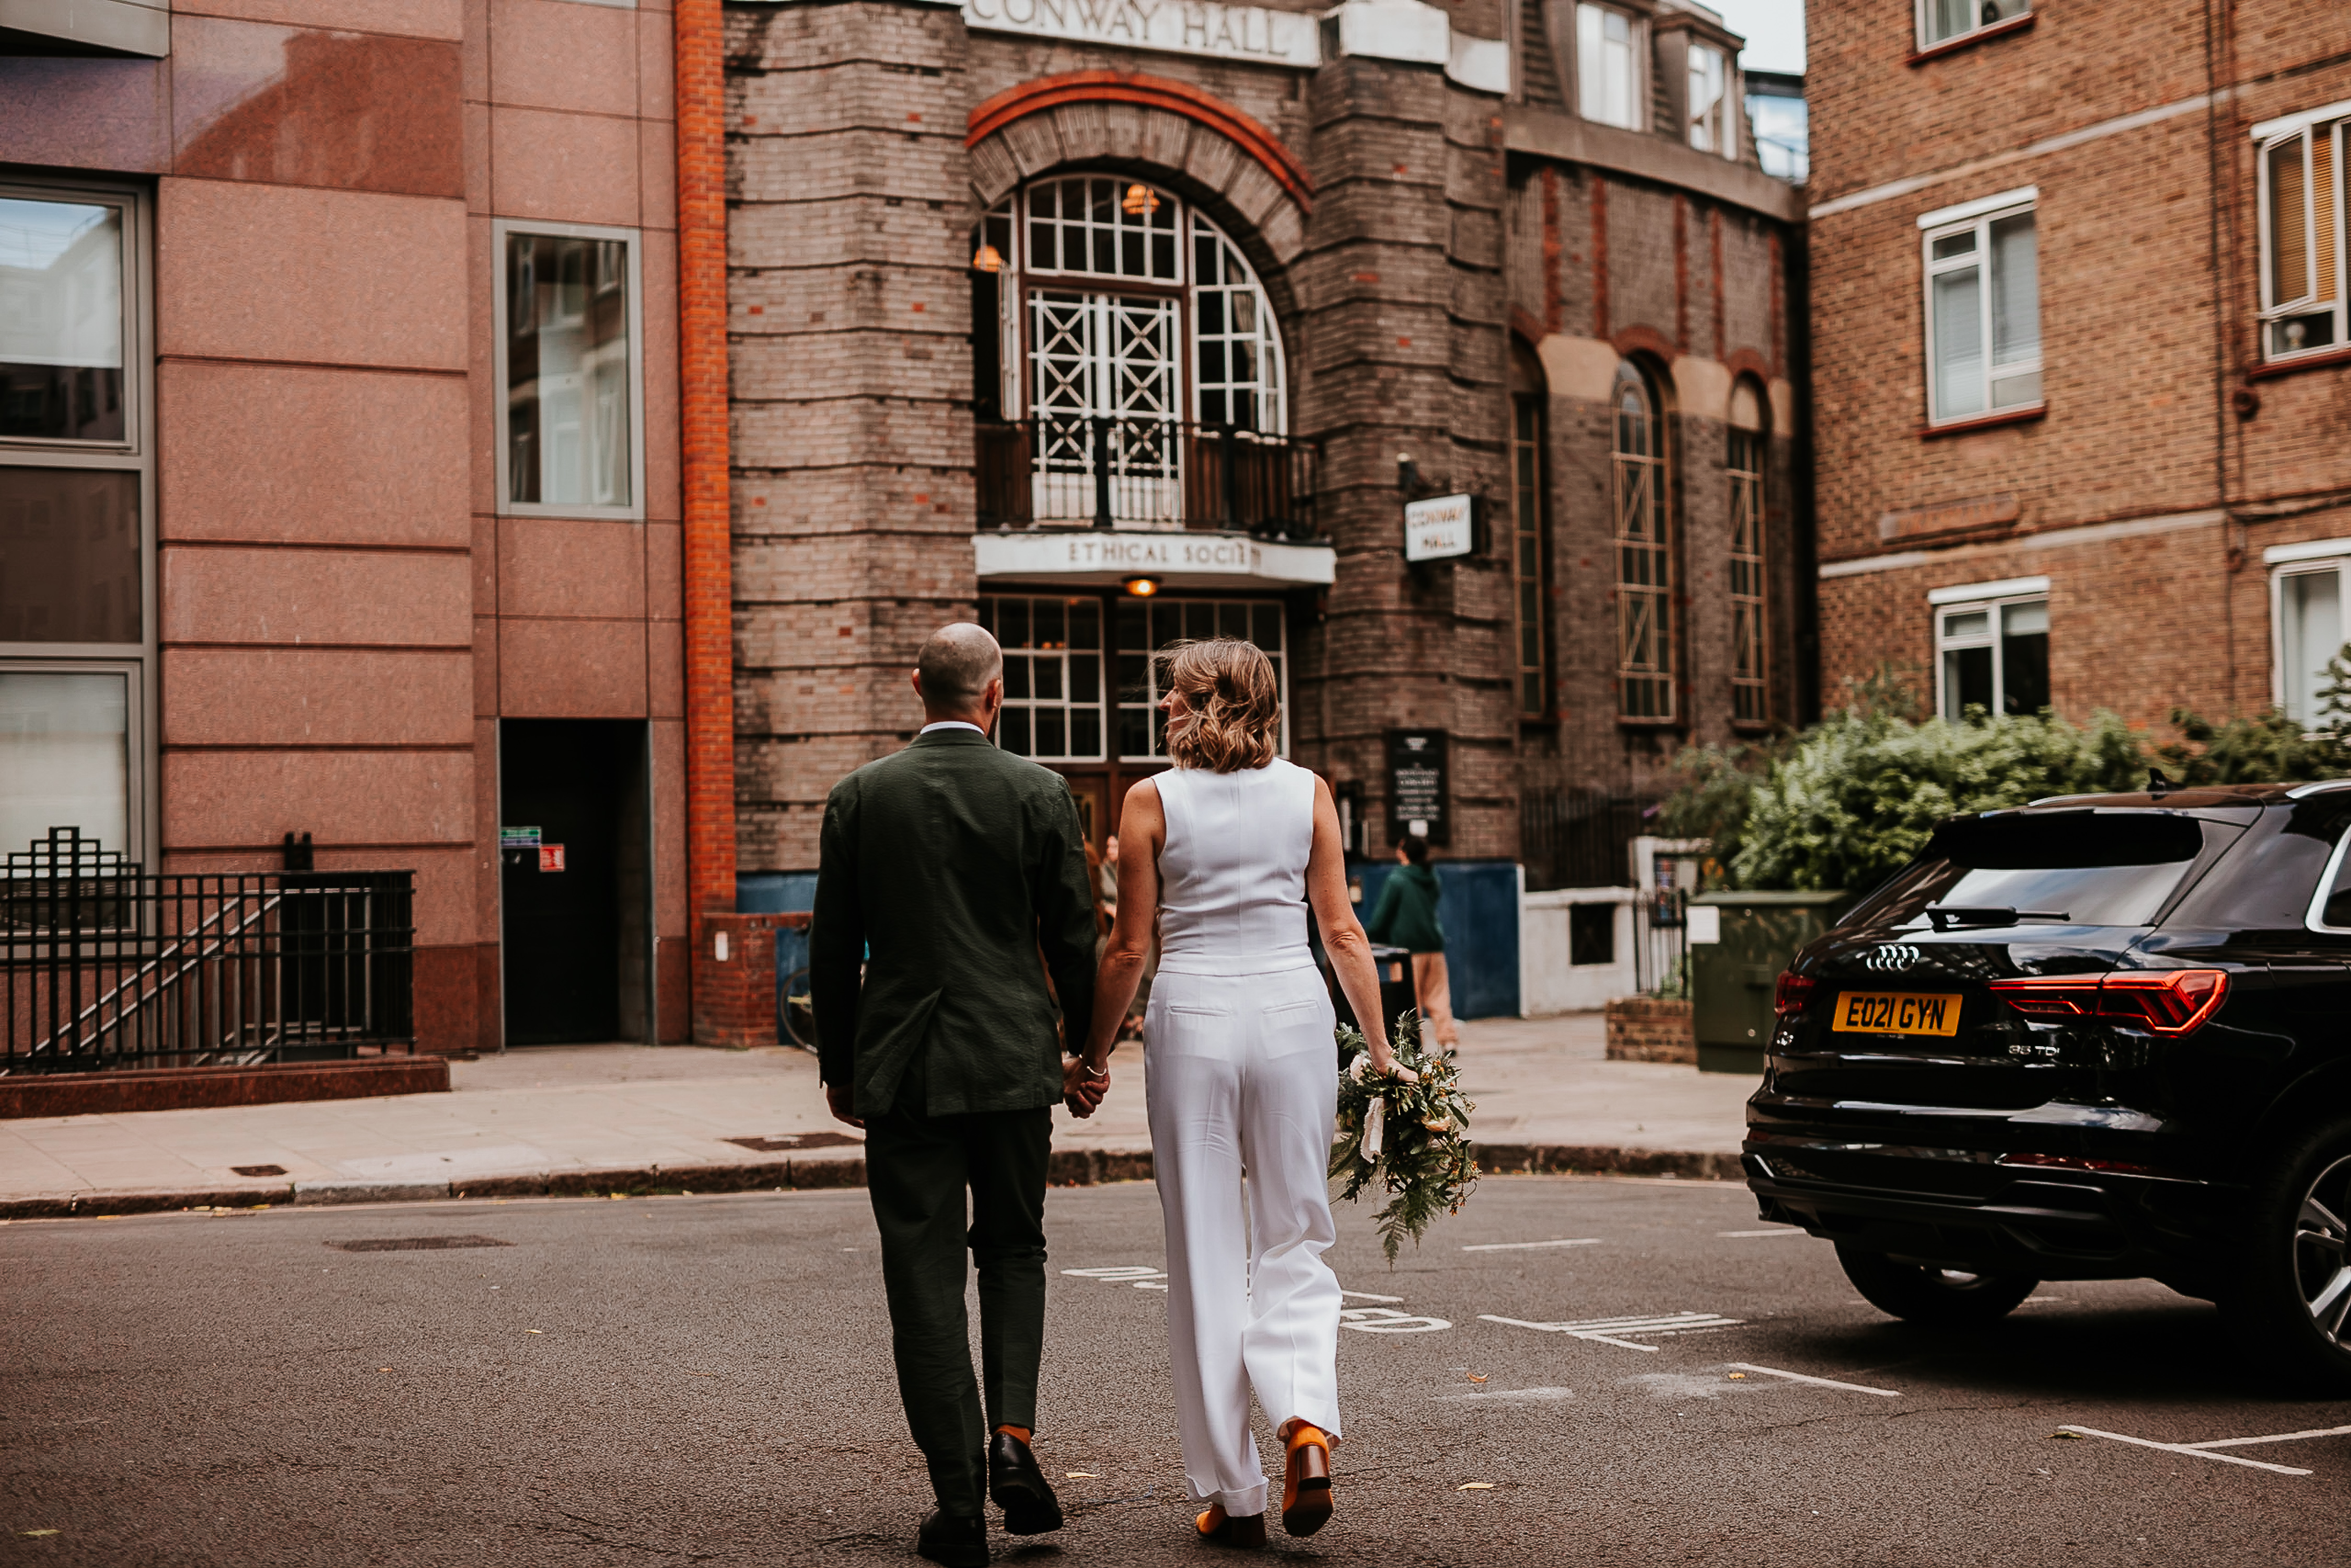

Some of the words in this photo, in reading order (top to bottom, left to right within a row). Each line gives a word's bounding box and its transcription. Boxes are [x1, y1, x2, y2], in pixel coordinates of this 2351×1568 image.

[1182, 5, 1290, 56] HALL
[1068, 541, 1170, 563] ETHICAL
[1899, 998, 1947, 1030] GYN
